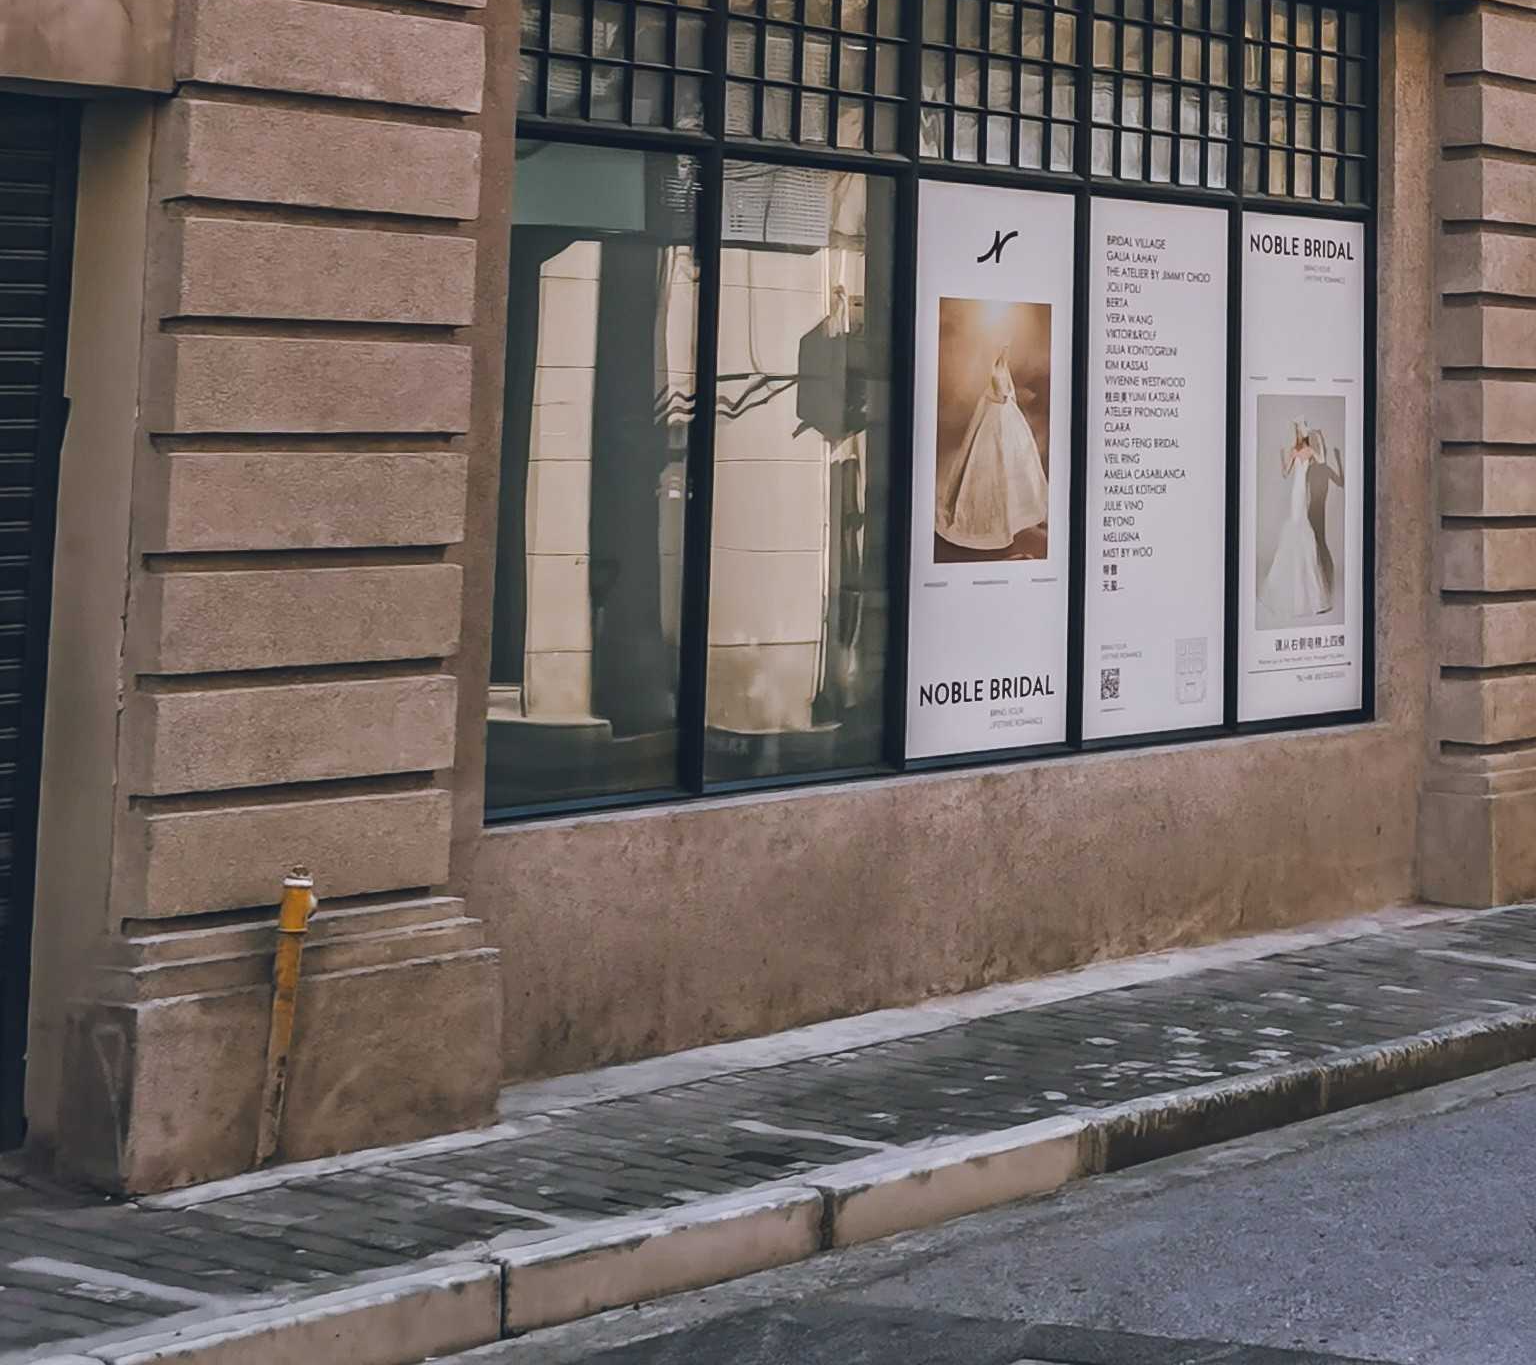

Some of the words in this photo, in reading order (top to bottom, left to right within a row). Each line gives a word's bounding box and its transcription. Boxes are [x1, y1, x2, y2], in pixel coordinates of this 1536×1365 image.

[1107, 235, 1133, 247] BRIDAL
[1135, 238, 1166, 250] VILLAGE
[1250, 234, 1299, 256] NOBLE
[1304, 238, 1354, 261] BRIDAL
[1107, 266, 1120, 277] THE
[1122, 267, 1149, 279] ATELIER
[1187, 272, 1211, 283] CHOO
[1106, 313, 1126, 324] VERA
[1128, 315, 1153, 326] WANG
[1105, 375, 1140, 387] VIVIENNE
[1142, 376, 1186, 388] WESTWOOD
[1105, 422, 1131, 433] CLARA
[1105, 438, 1130, 448] WANG
[1132, 438, 1152, 449] FENG
[1154, 438, 1179, 448] BRIDAL
[1104, 469, 1132, 480] AMELIA
[1134, 469, 1186, 480] CASABLANCA
[1104, 516, 1135, 527] BEYOND
[919, 680, 984, 707] NOBLE
[990, 674, 1055, 700] BRIDAL
